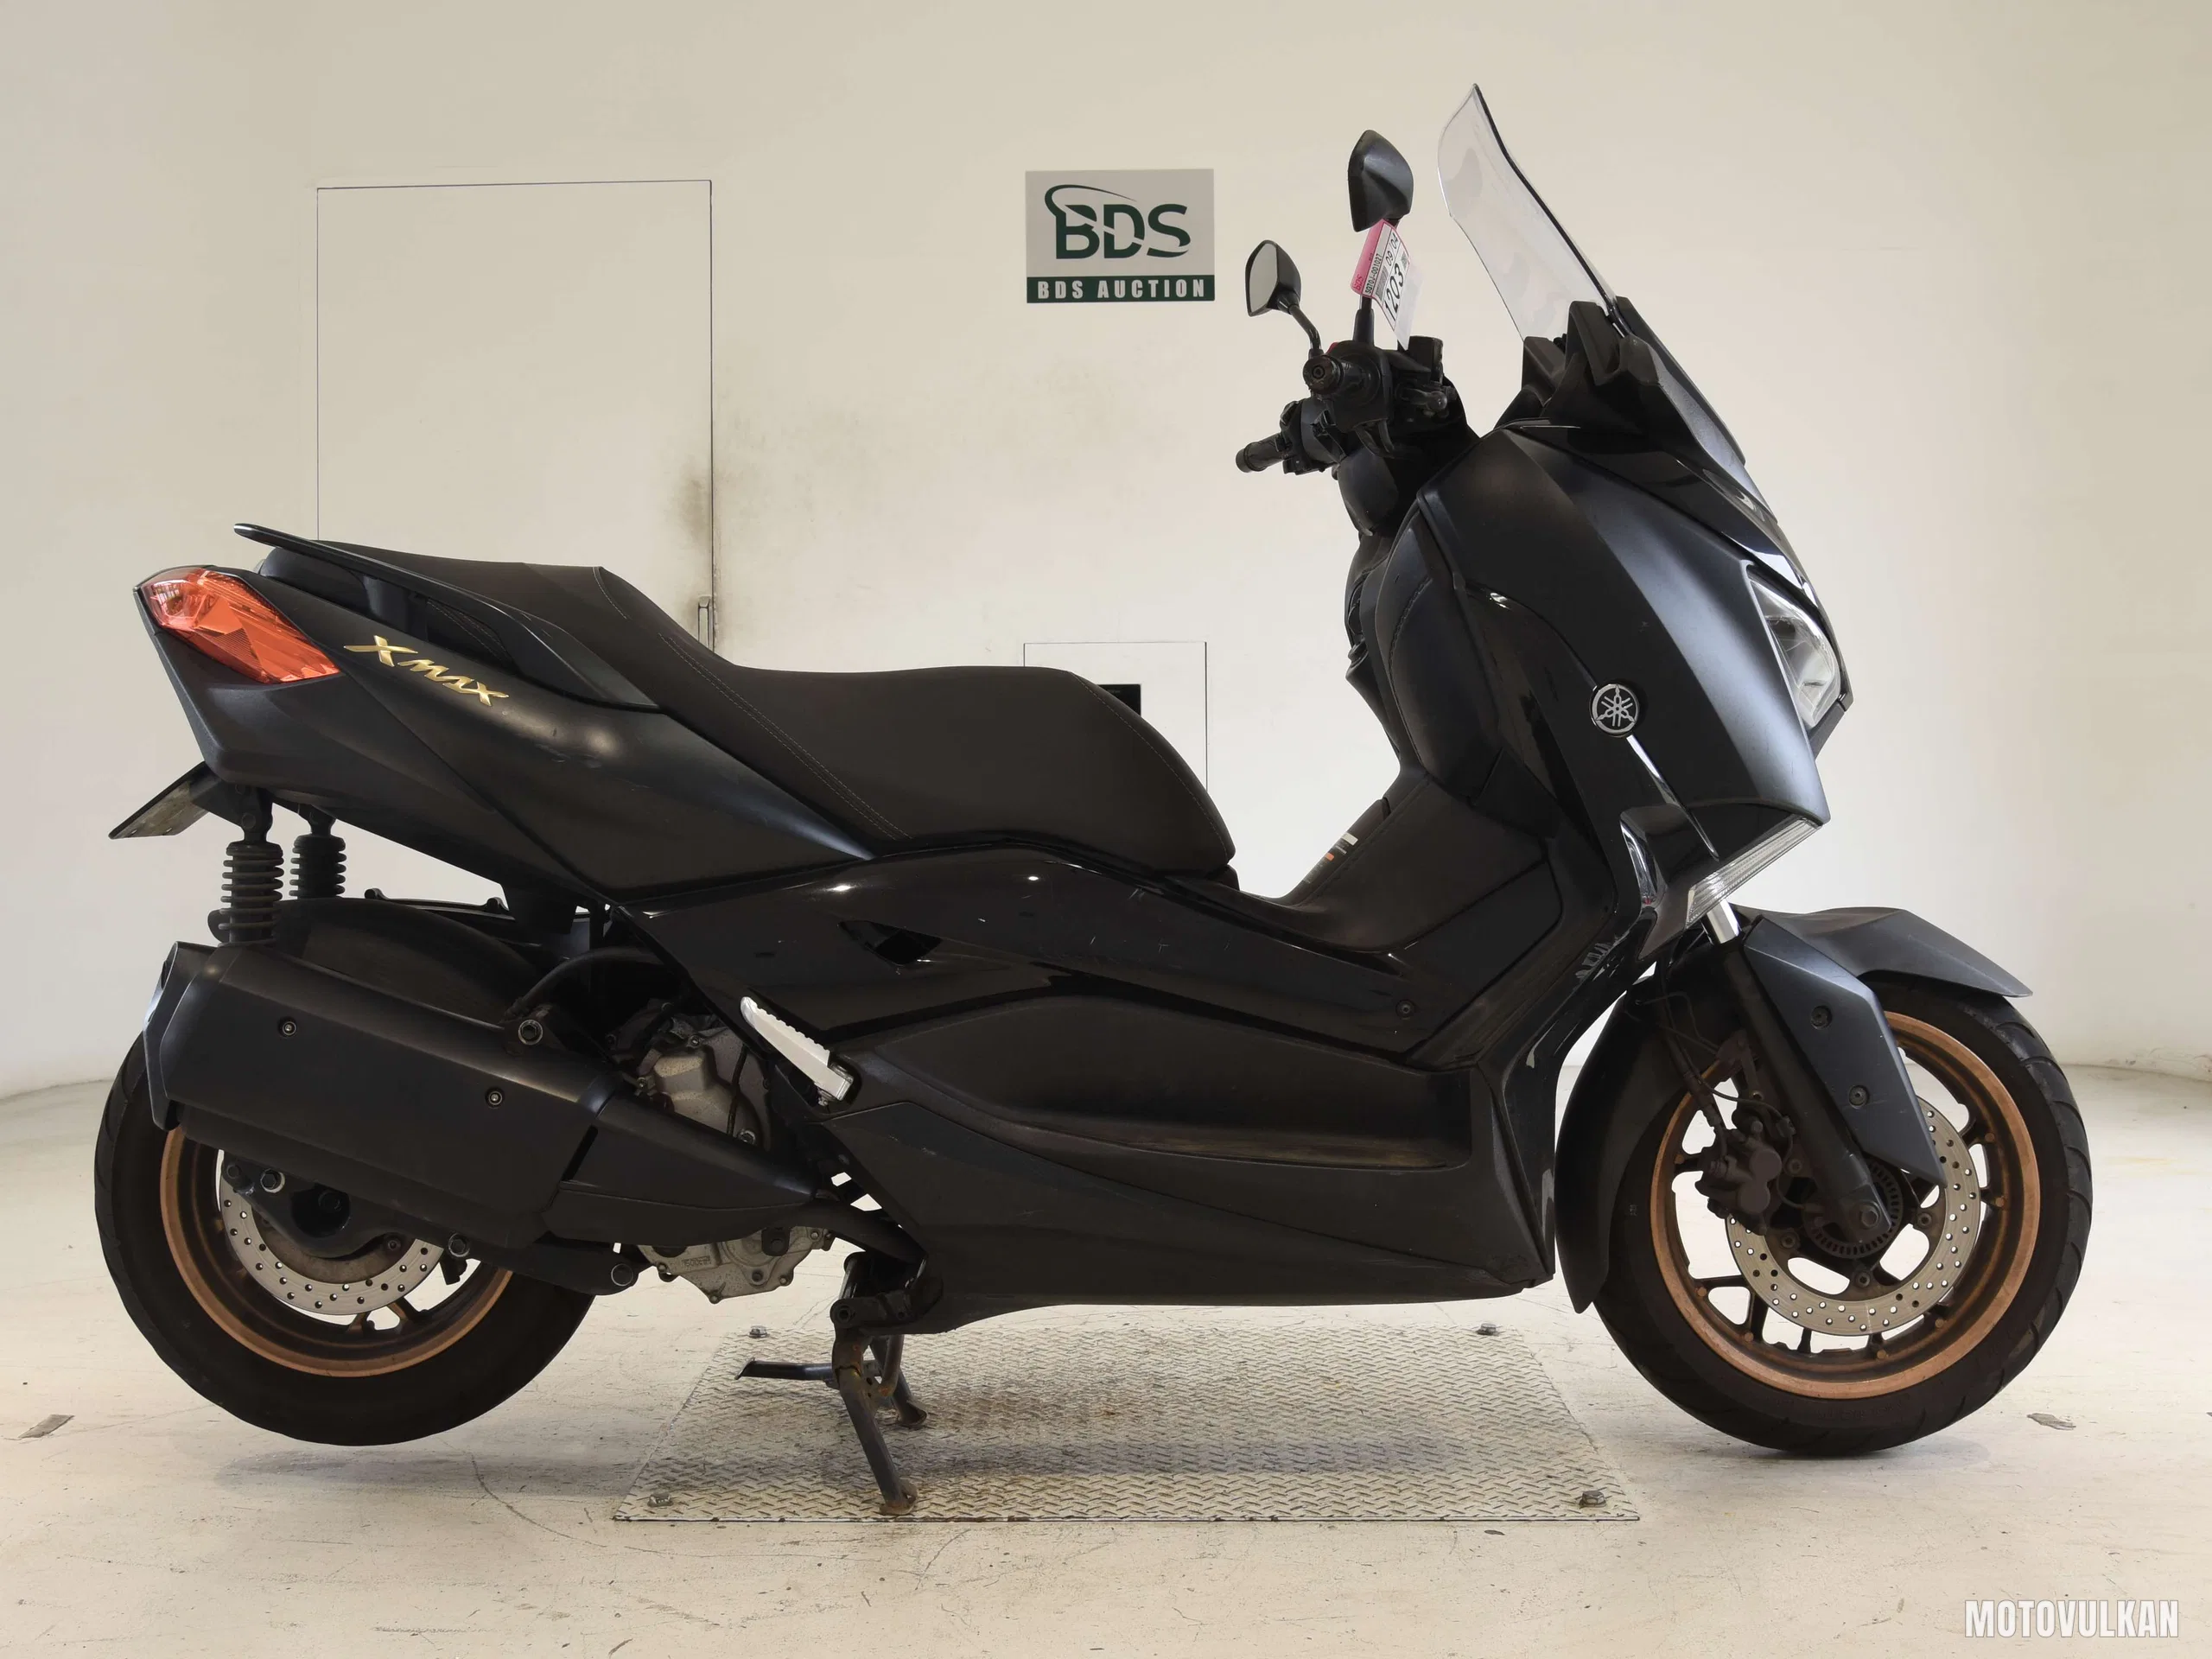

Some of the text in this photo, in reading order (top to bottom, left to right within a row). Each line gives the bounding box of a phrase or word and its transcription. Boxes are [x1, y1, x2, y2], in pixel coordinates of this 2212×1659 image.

[1045, 184, 1191, 258] BDS
[1038, 279, 1205, 299] BDS AUCTION
[1385, 263, 1404, 322] 1203
[343, 635, 510, 707] XMAX
